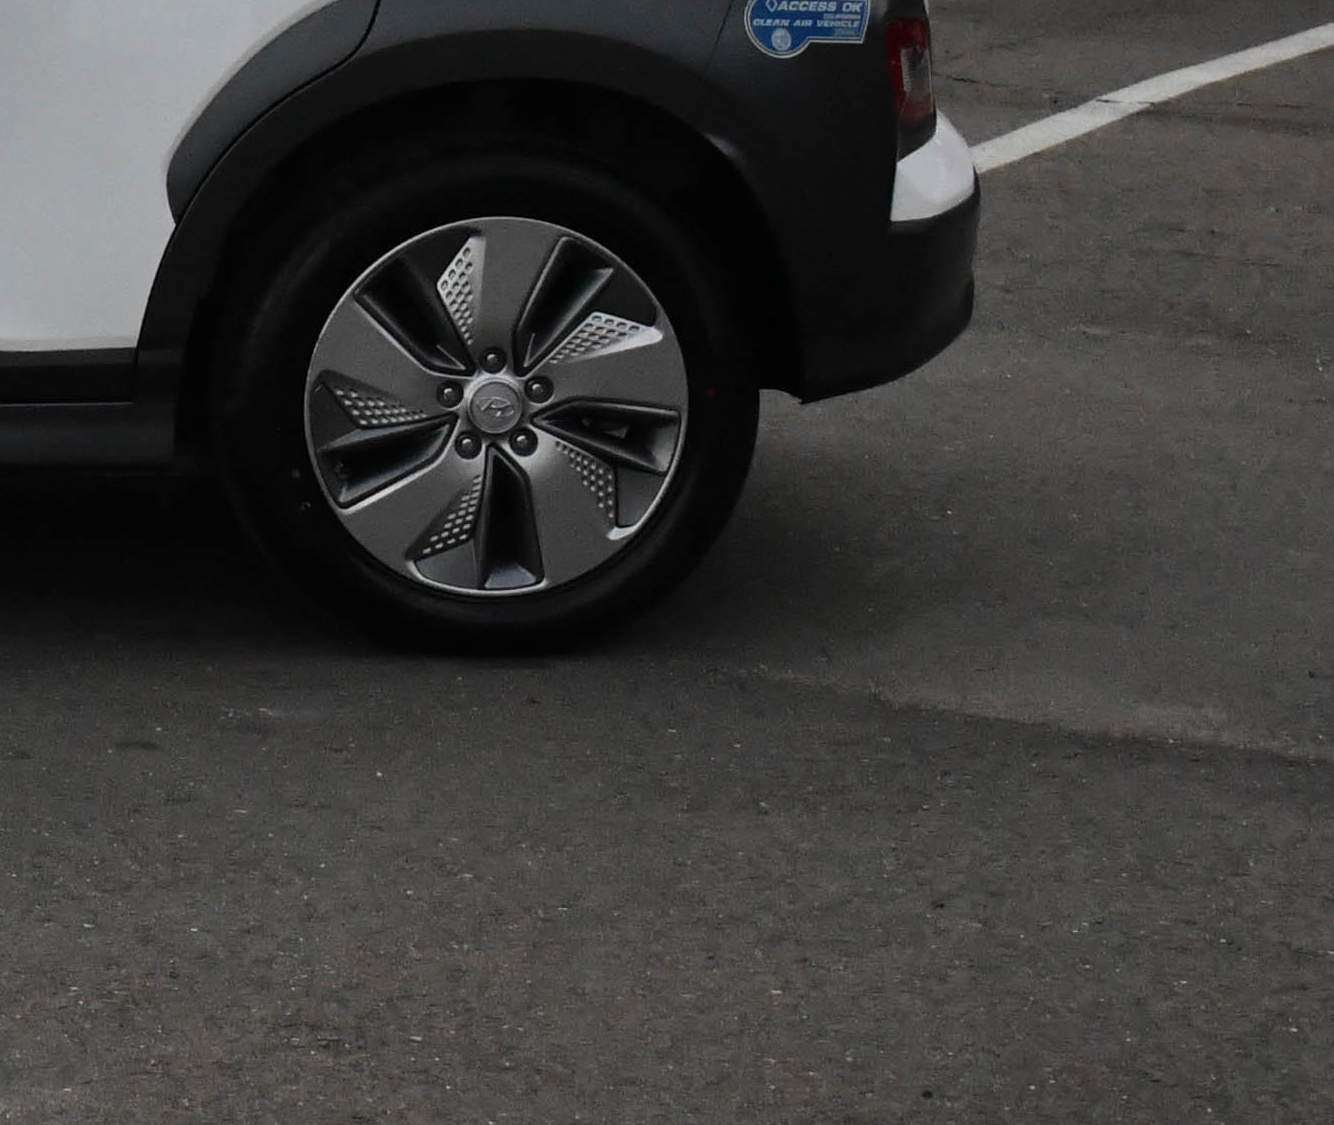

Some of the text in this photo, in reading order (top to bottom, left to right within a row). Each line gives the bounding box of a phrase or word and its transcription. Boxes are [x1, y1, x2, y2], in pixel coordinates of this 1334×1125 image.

[777, 0, 863, 13] ACCESS OK
[753, 18, 789, 26] CLEAN
